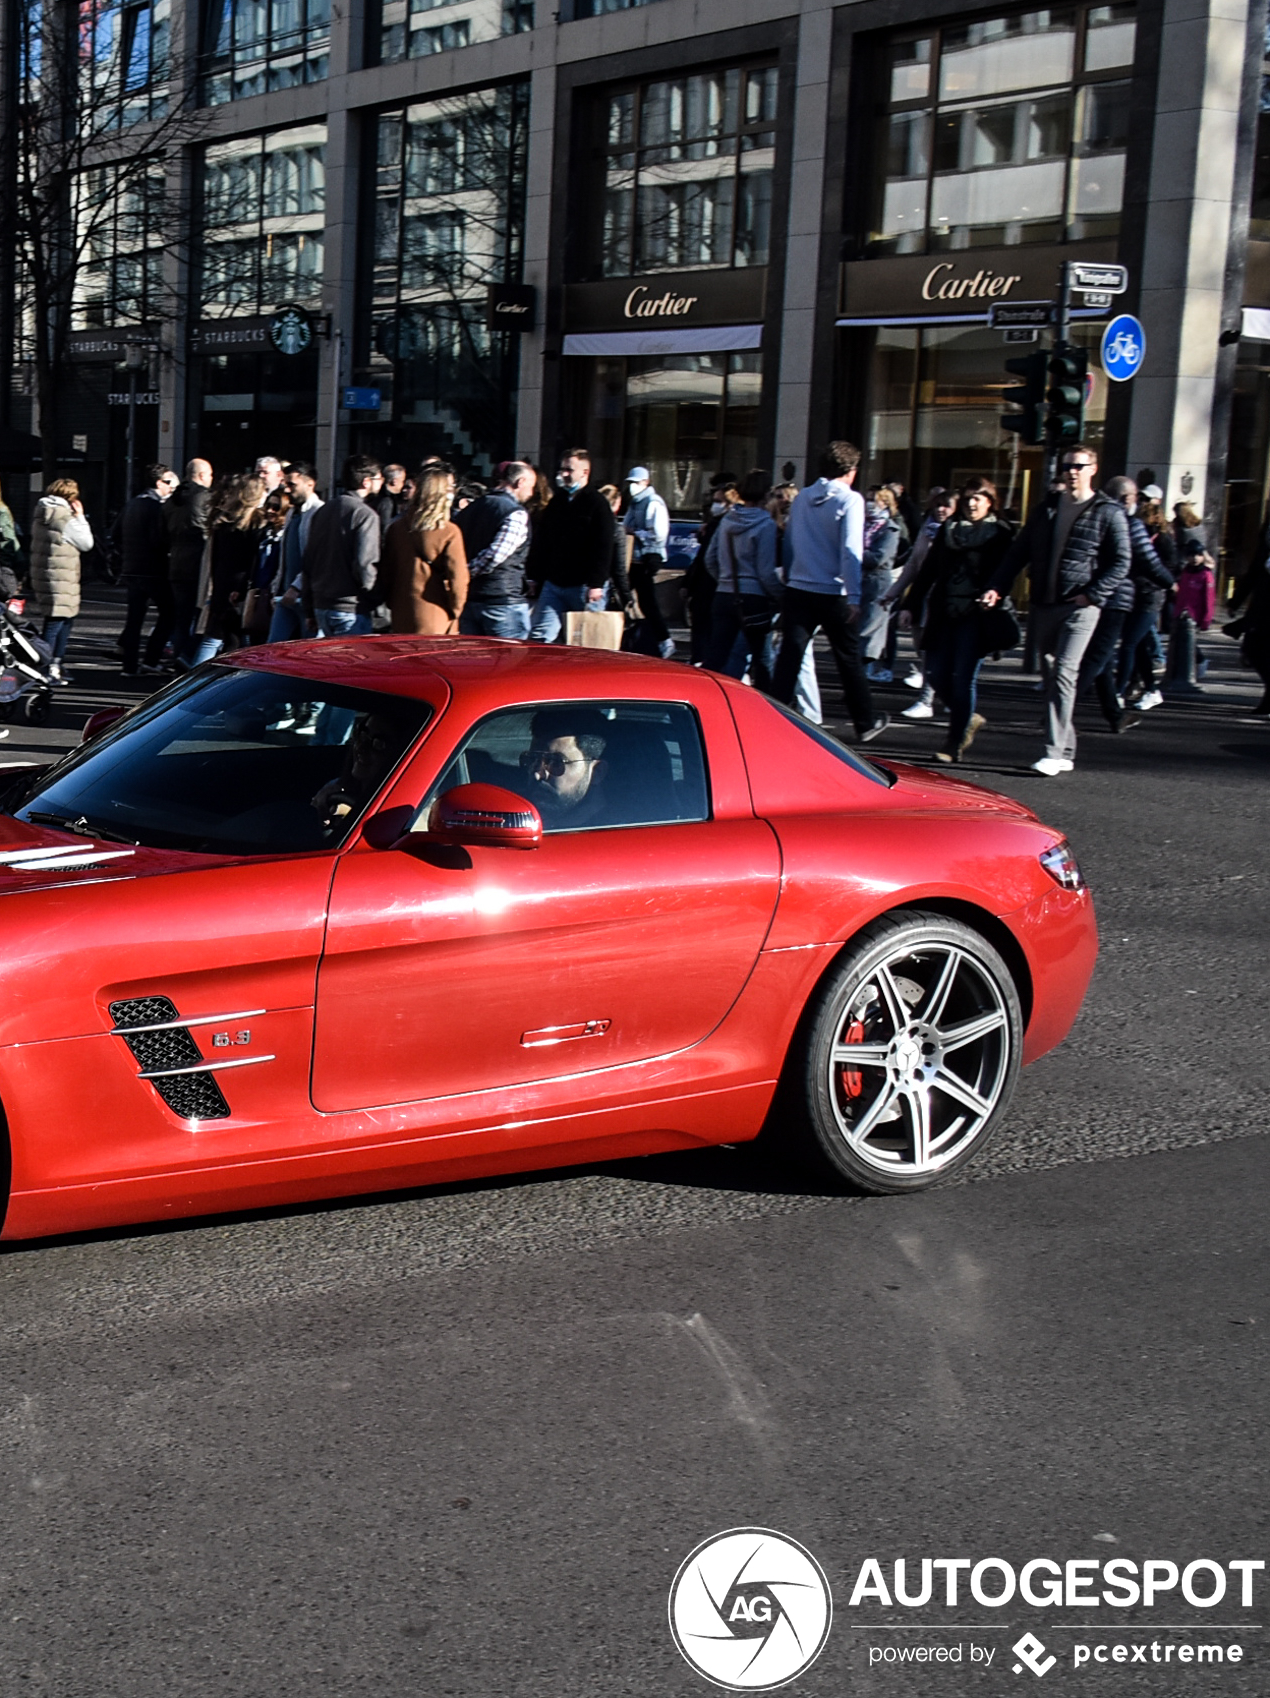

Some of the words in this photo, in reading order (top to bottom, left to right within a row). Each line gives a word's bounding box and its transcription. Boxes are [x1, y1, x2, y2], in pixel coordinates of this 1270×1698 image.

[922, 263, 1020, 300] Cartier
[496, 302, 529, 313] Cartier
[624, 286, 697, 318] Cartier
[204, 329, 265, 344] STARBUCKS
[213, 1029, 251, 1047] 6.3
